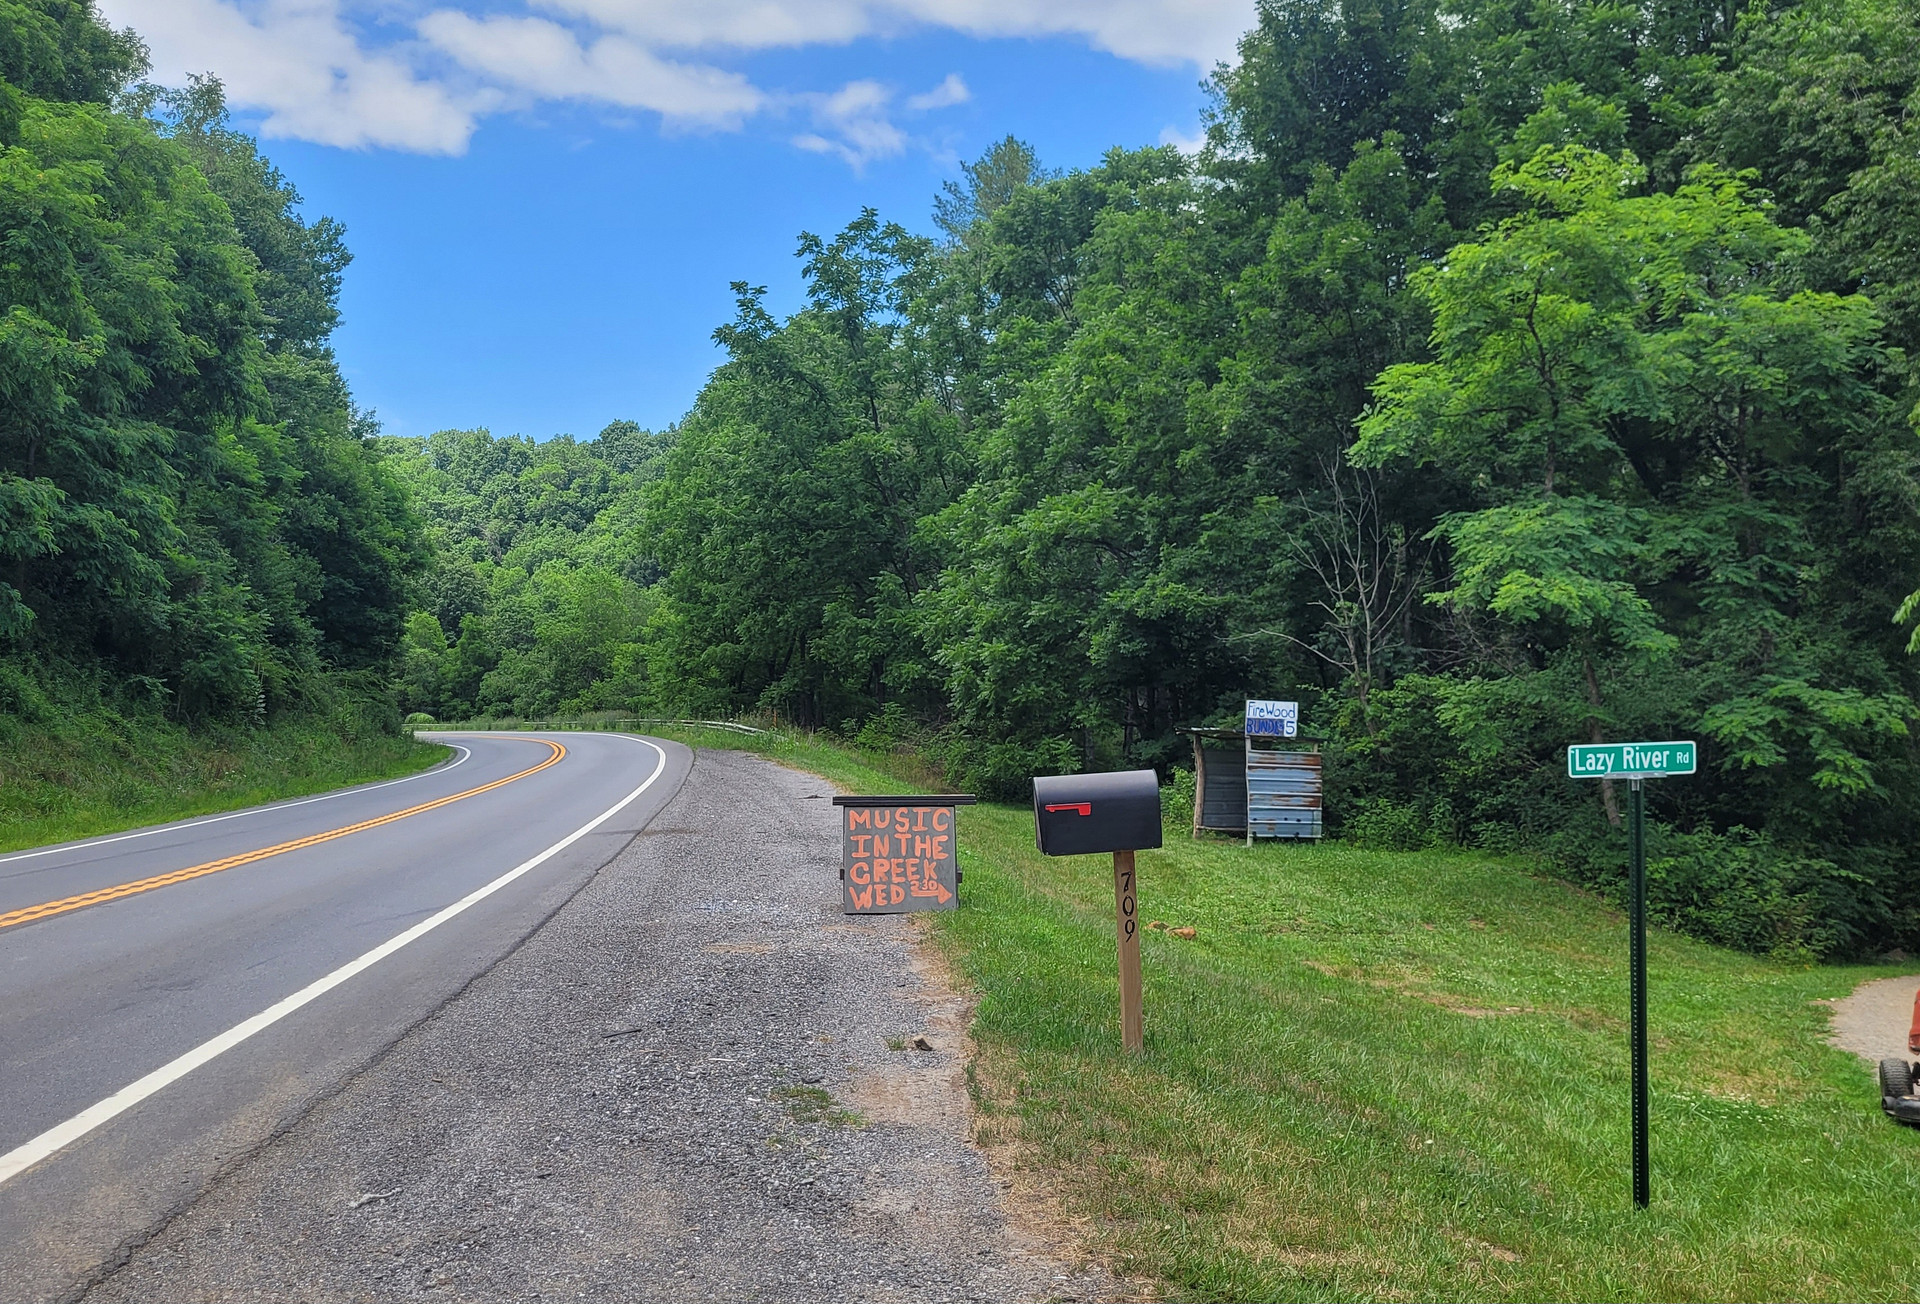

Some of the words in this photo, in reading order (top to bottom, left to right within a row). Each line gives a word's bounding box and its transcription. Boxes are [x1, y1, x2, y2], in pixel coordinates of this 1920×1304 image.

[1575, 748, 1615, 773] Lazy
[1622, 746, 1670, 769] River
[1676, 751, 1690, 764] Rd
[849, 807, 951, 832] MUSIC
[850, 834, 890, 858] IN
[894, 833, 949, 860] THE
[849, 858, 938, 885] CREEK
[849, 884, 905, 910] WED
[1121, 871, 1135, 943] 709
